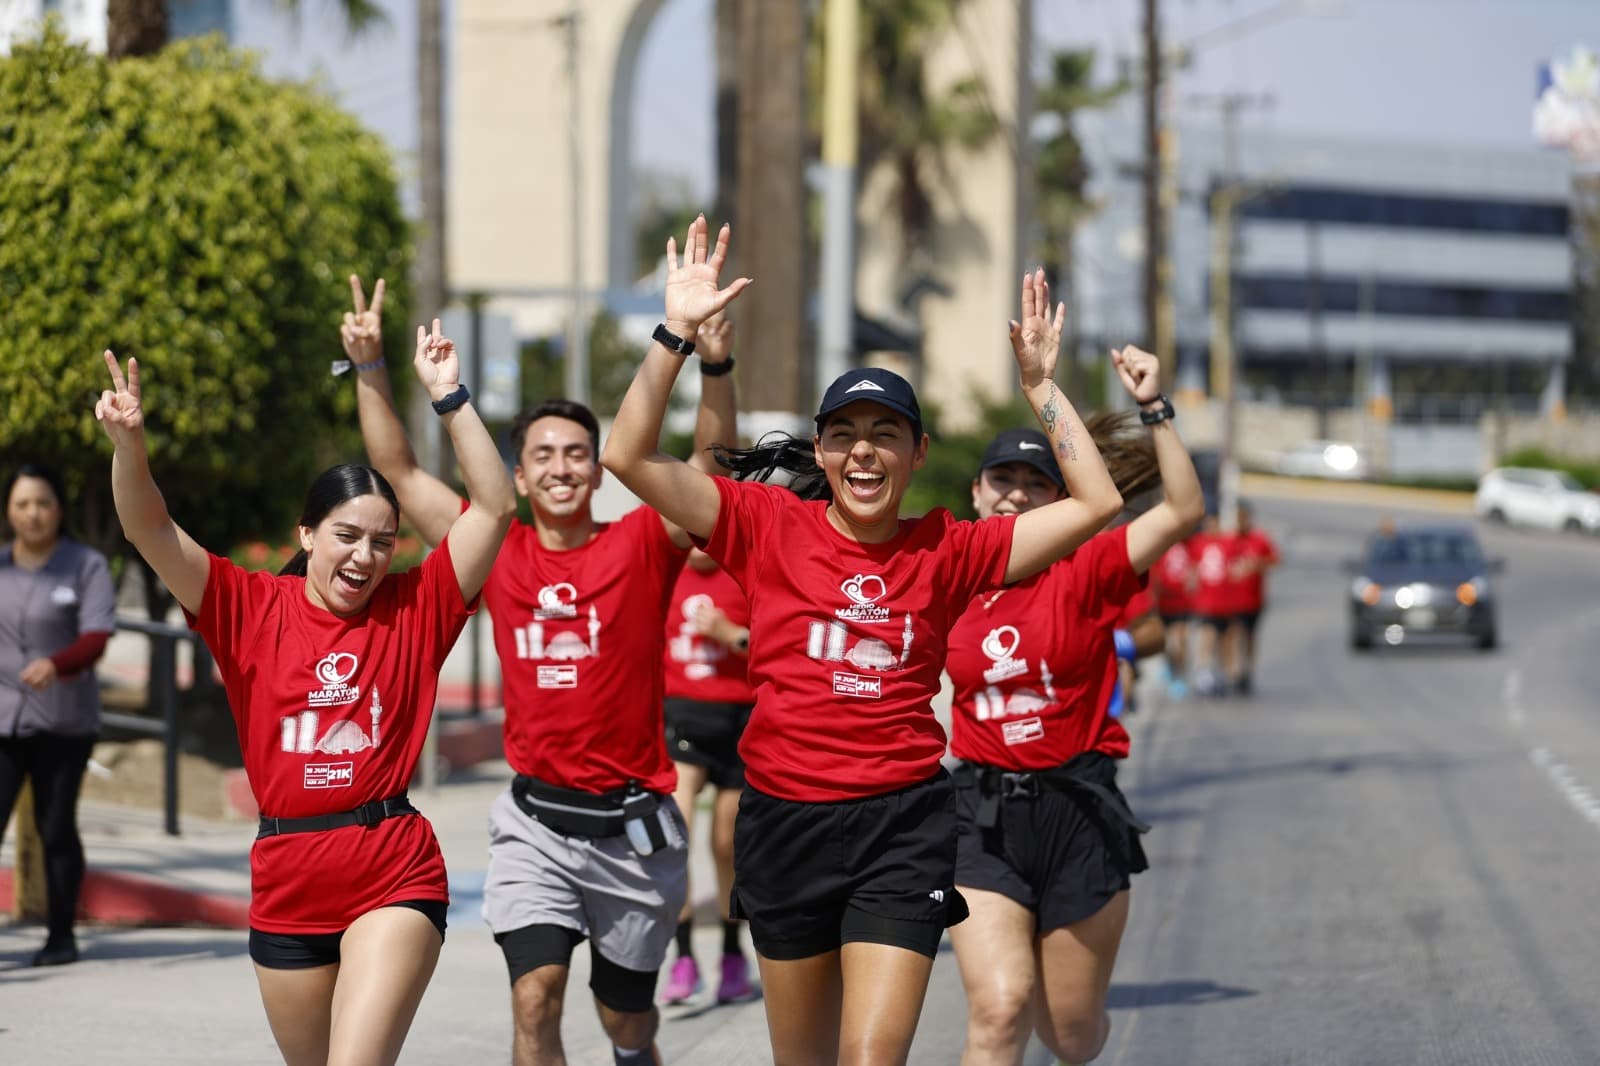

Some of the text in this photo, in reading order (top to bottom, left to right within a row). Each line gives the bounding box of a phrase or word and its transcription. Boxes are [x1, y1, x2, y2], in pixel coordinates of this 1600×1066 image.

[835, 607, 890, 616] MARATÓN
[308, 686, 360, 699] MARATÓN
[323, 683, 348, 691] MEDIO
[857, 681, 879, 693] 21K
[328, 768, 351, 780] 21K
